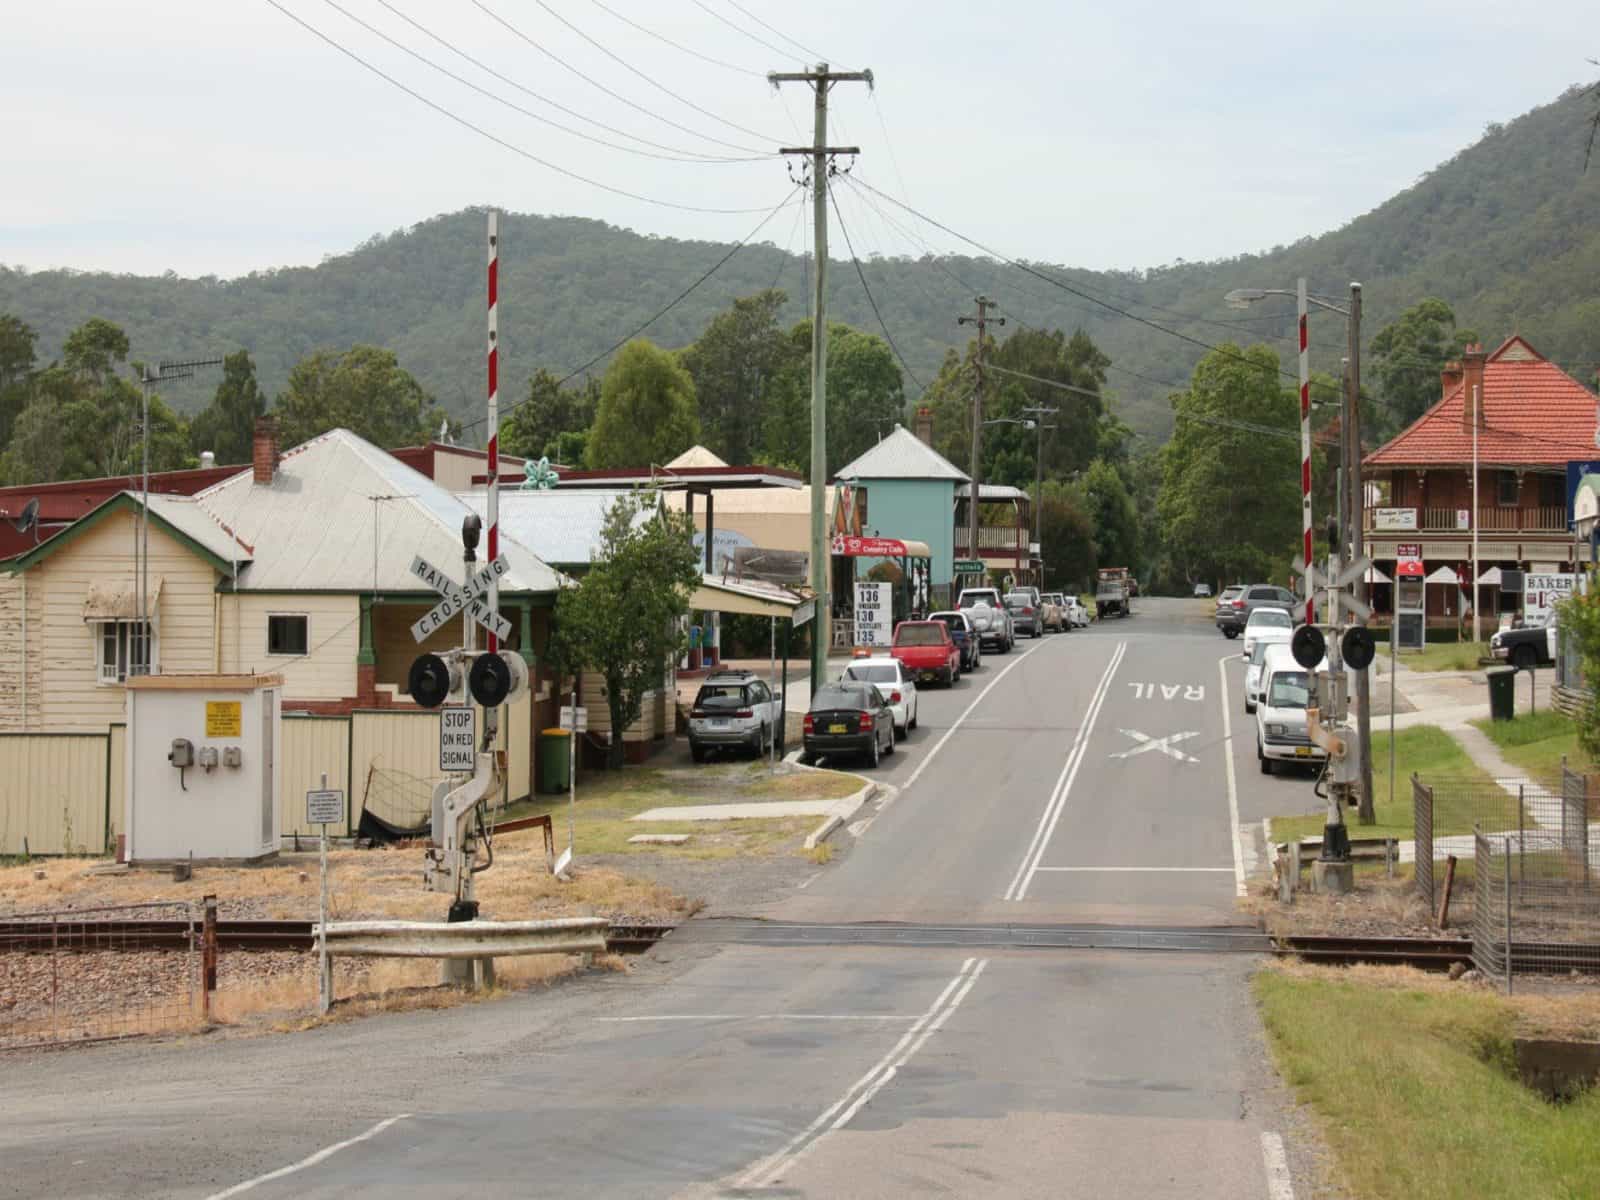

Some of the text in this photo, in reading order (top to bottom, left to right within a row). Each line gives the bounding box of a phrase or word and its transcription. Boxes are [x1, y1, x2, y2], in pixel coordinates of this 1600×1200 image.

[417, 561, 504, 632] RAIL WAY
[419, 560, 503, 634] CROSSING
[860, 590, 879, 602] 136
[857, 630, 875, 642] 135
[1127, 682, 1205, 701] RAIL
[445, 712, 471, 728] STOP
[443, 733, 473, 746] ON RED
[442, 751, 473, 764] SIGNAL
